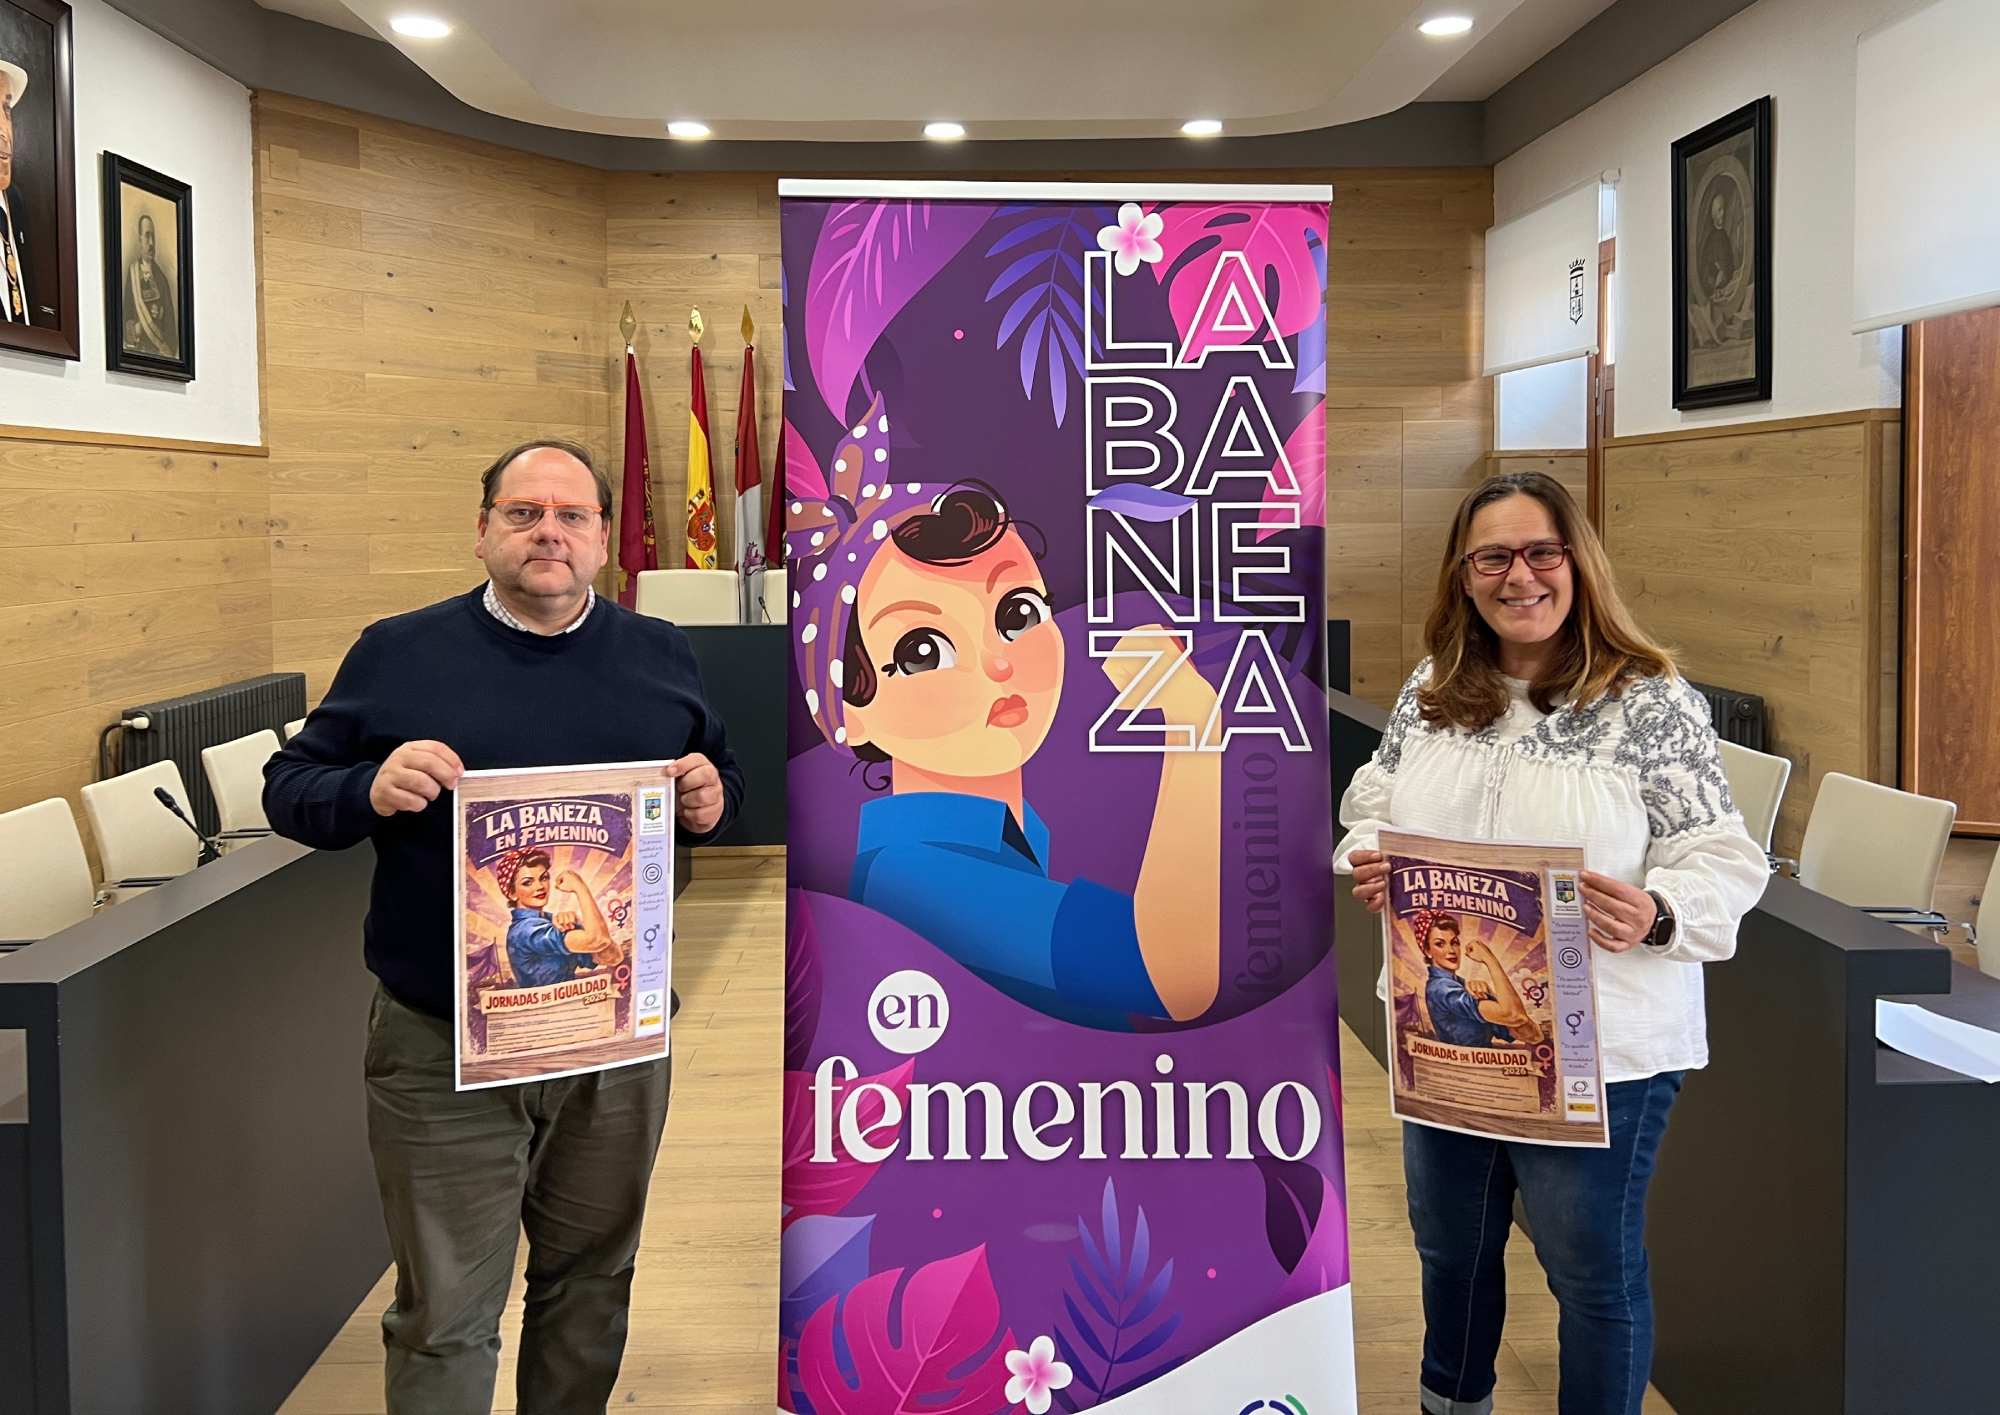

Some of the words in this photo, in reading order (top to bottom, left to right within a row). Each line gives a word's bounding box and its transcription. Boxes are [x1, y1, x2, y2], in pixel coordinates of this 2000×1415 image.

[1084, 251, 1294, 369] LA
[1085, 376, 1301, 495] BA
[1088, 630, 1312, 752] ZA
[486, 811, 515, 839] LA
[518, 803, 603, 827] BAÑEZA
[496, 832, 516, 852] EN
[519, 826, 609, 847] FEMENINO
[1403, 871, 1426, 892] LA
[1429, 870, 1510, 902] BAÑEZA
[1411, 893, 1427, 907] EN
[1430, 890, 1518, 921] FEMENINO
[485, 992, 539, 1010] JORNADAS
[541, 992, 552, 1002] DE
[553, 979, 608, 1001] IGUALDAD
[876, 991, 941, 1029] en
[1411, 1041, 1458, 1061] JORNADAS
[1460, 1053, 1470, 1061] DE
[1471, 1051, 1527, 1066] IGUALDAD
[1503, 1067, 1527, 1076] 2026
[808, 1054, 1322, 1163] femenino
